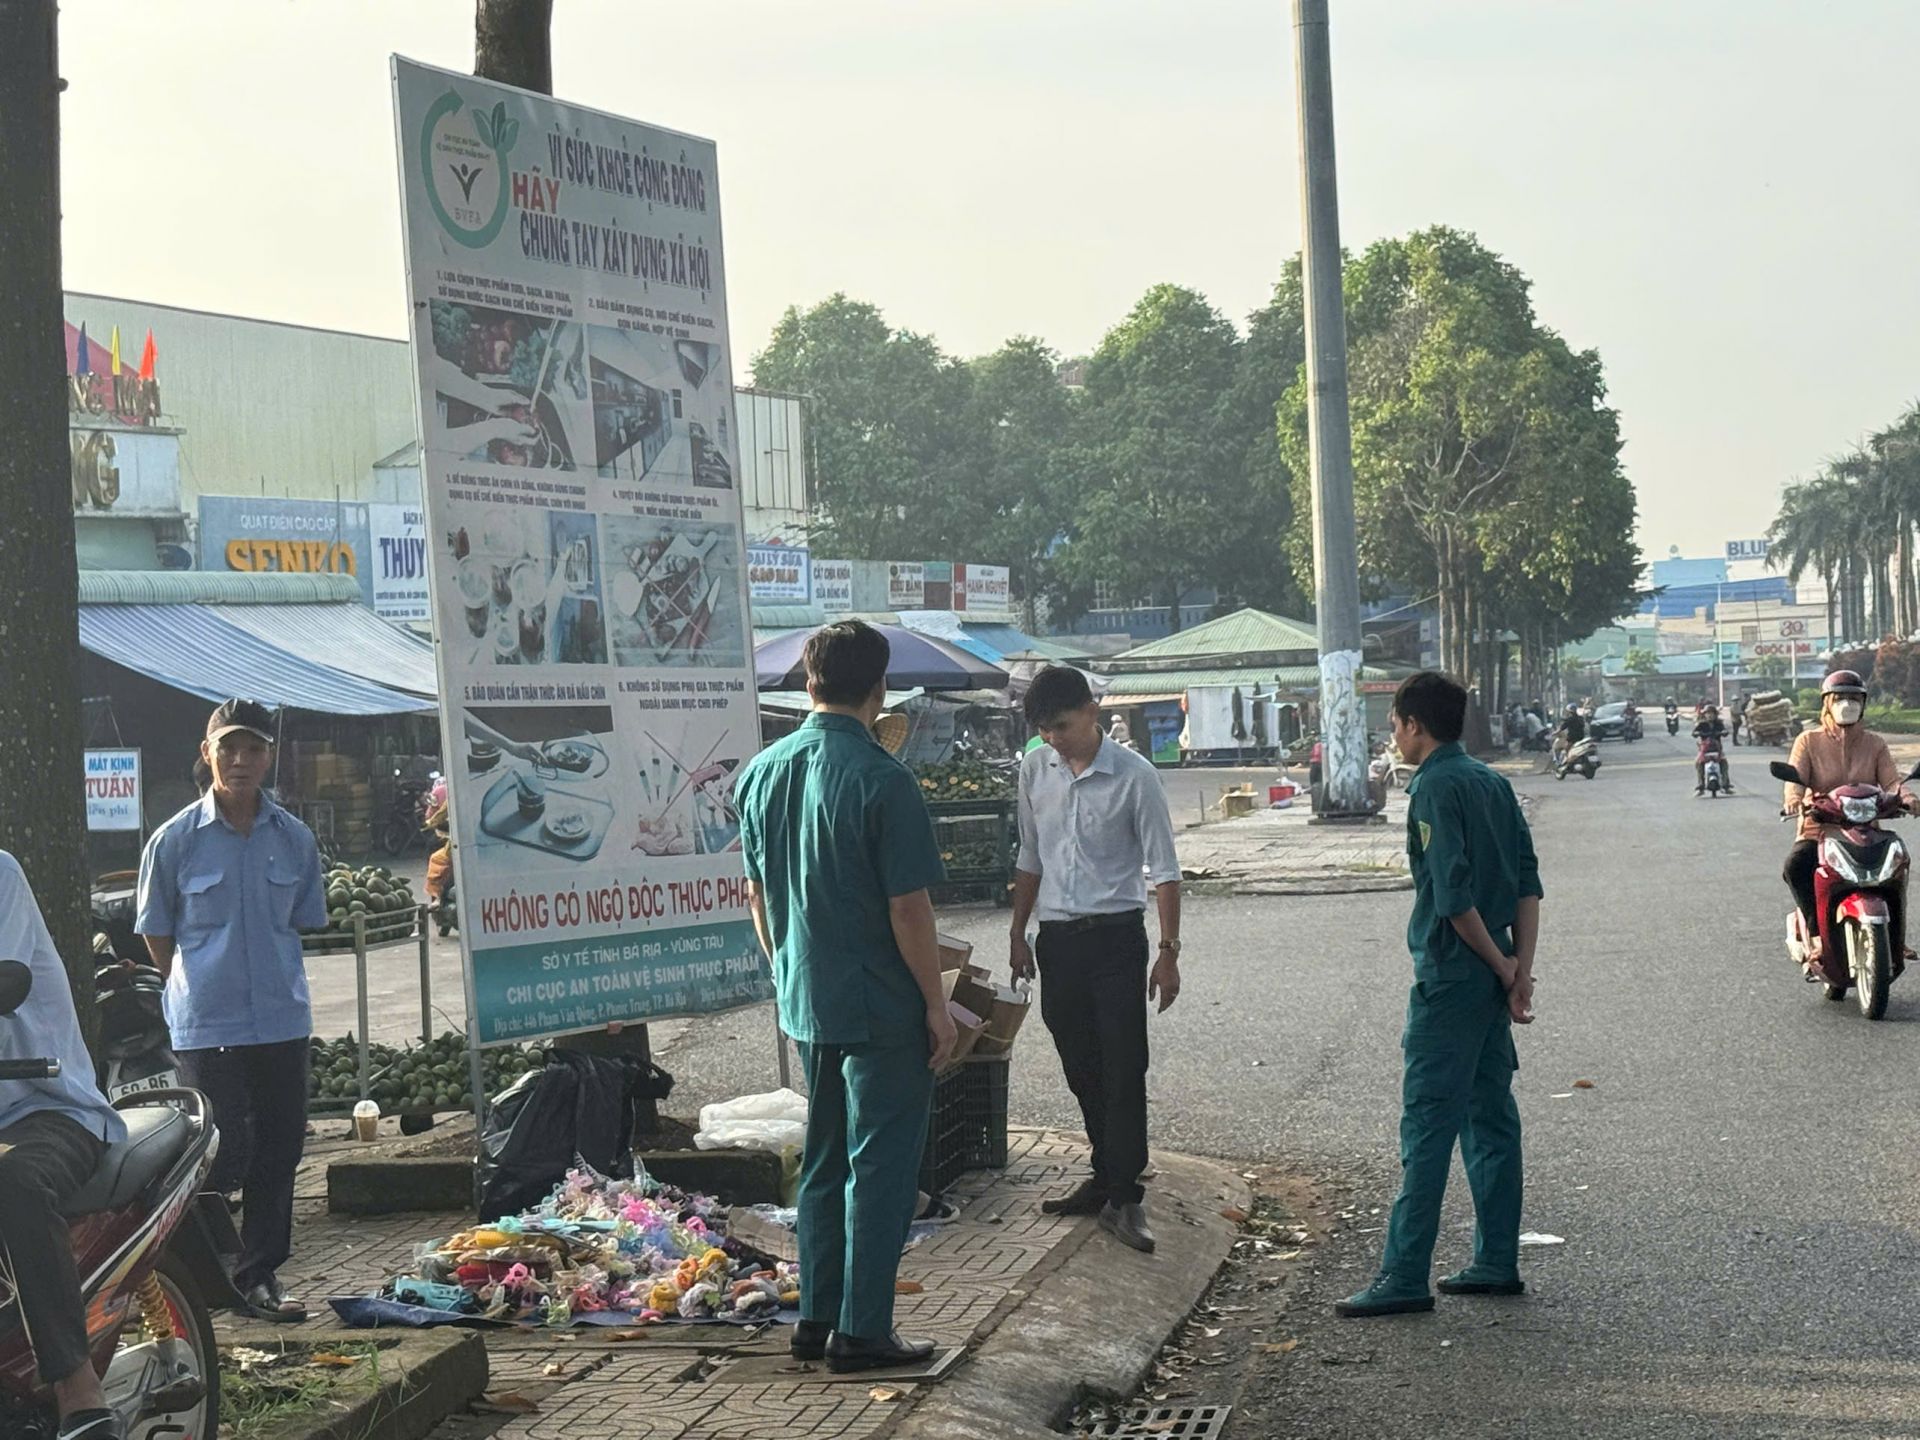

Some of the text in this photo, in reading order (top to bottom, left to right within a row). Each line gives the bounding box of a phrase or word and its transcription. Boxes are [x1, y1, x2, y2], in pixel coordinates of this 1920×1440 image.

[512, 165, 560, 214] HÃY
[548, 123, 562, 179] VÌ
[566, 128, 594, 186] SỨC
[634, 146, 669, 212] CỘNG
[672, 150, 705, 211] ĐỒNG
[520, 211, 710, 301] CHUNG TAY XÂY DỰNG XÃ HỘI
[295, 517, 316, 530] CAO
[379, 527, 425, 579] THÚY
[465, 686, 472, 700] 5.
[662, 699, 681, 709] DANH
[697, 699, 711, 708] CHO
[86, 770, 135, 798] TUẤN
[481, 889, 549, 934] KHÔNG
[554, 881, 581, 927] CÓ
[587, 879, 624, 929] NGỘ
[630, 876, 664, 926] ĐỘC
[668, 876, 712, 920] THỰC
[507, 948, 759, 1005] CHI CỤC AN TOÀN VỆ SINH THỰC PHẨM
[562, 953, 570, 966] Y
[573, 947, 590, 966] TẾ
[623, 944, 640, 960] BÀ
[642, 942, 661, 961] RỊA
[670, 938, 700, 954] VŨNG
